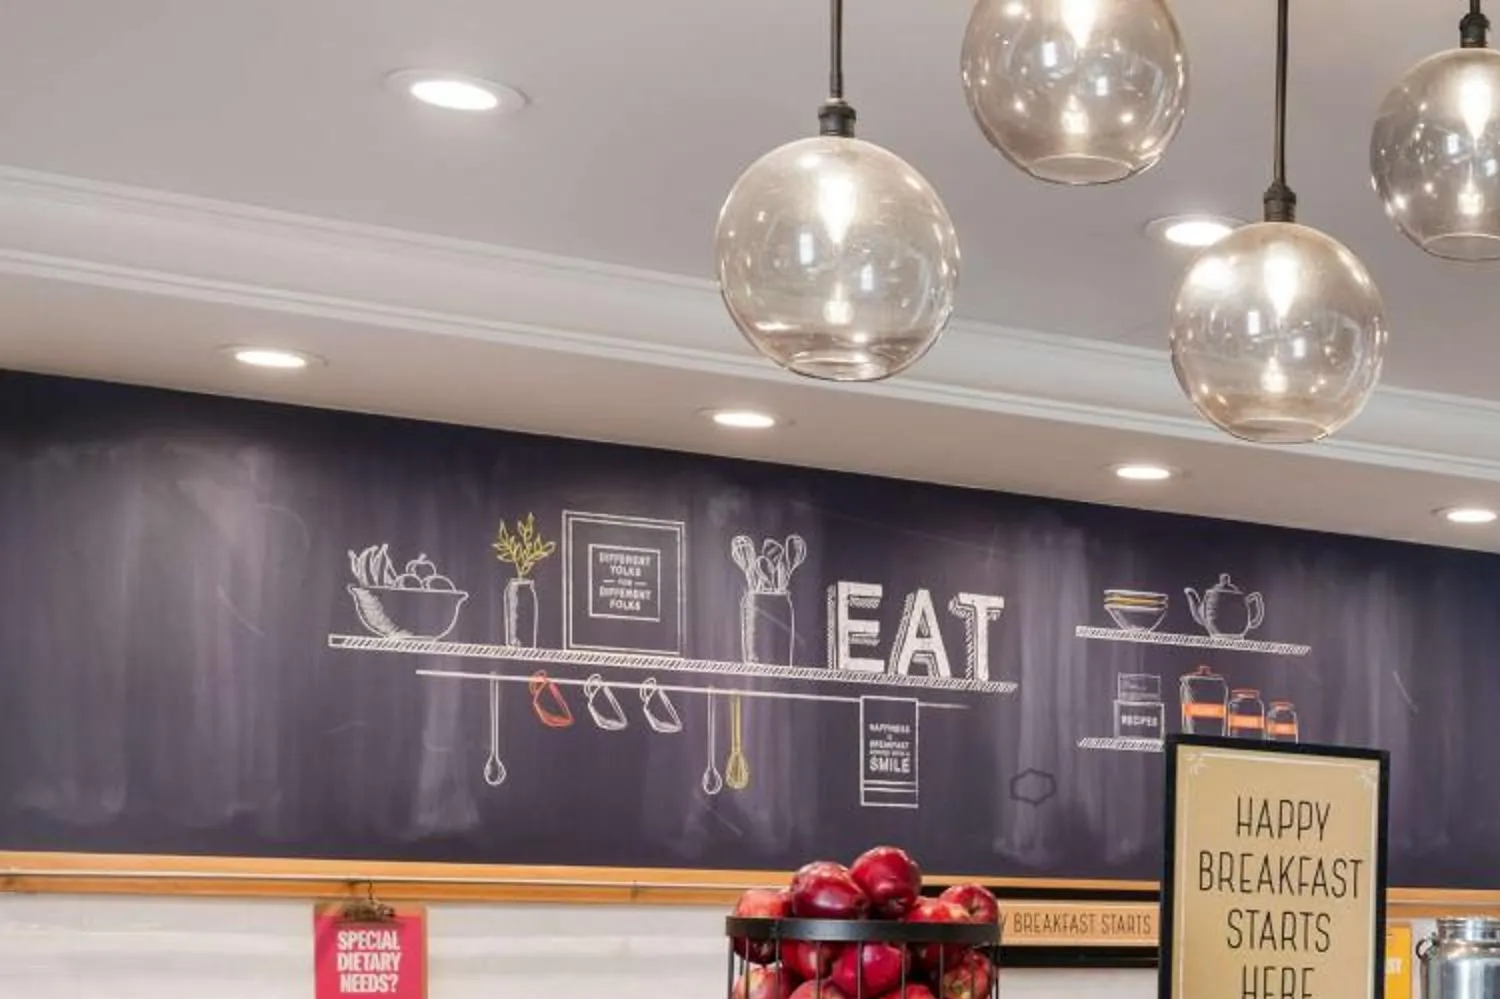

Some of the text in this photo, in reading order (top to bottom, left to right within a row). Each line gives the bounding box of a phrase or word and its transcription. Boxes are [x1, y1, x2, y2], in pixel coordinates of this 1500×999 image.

[609, 598, 641, 612] FOLKS
[827, 580, 1005, 682] EAT
[869, 756, 911, 773] SMILE
[1236, 796, 1331, 842] HAPPY
[1199, 850, 1364, 899] BREAKFAST
[1013, 911, 1097, 934] BREAKFAST
[1101, 913, 1152, 935] STARTS
[1226, 908, 1332, 953] STARTS
[337, 930, 401, 951] SPECIAL
[336, 951, 403, 972] DIETARY
[340, 973, 399, 994] NEEDS?
